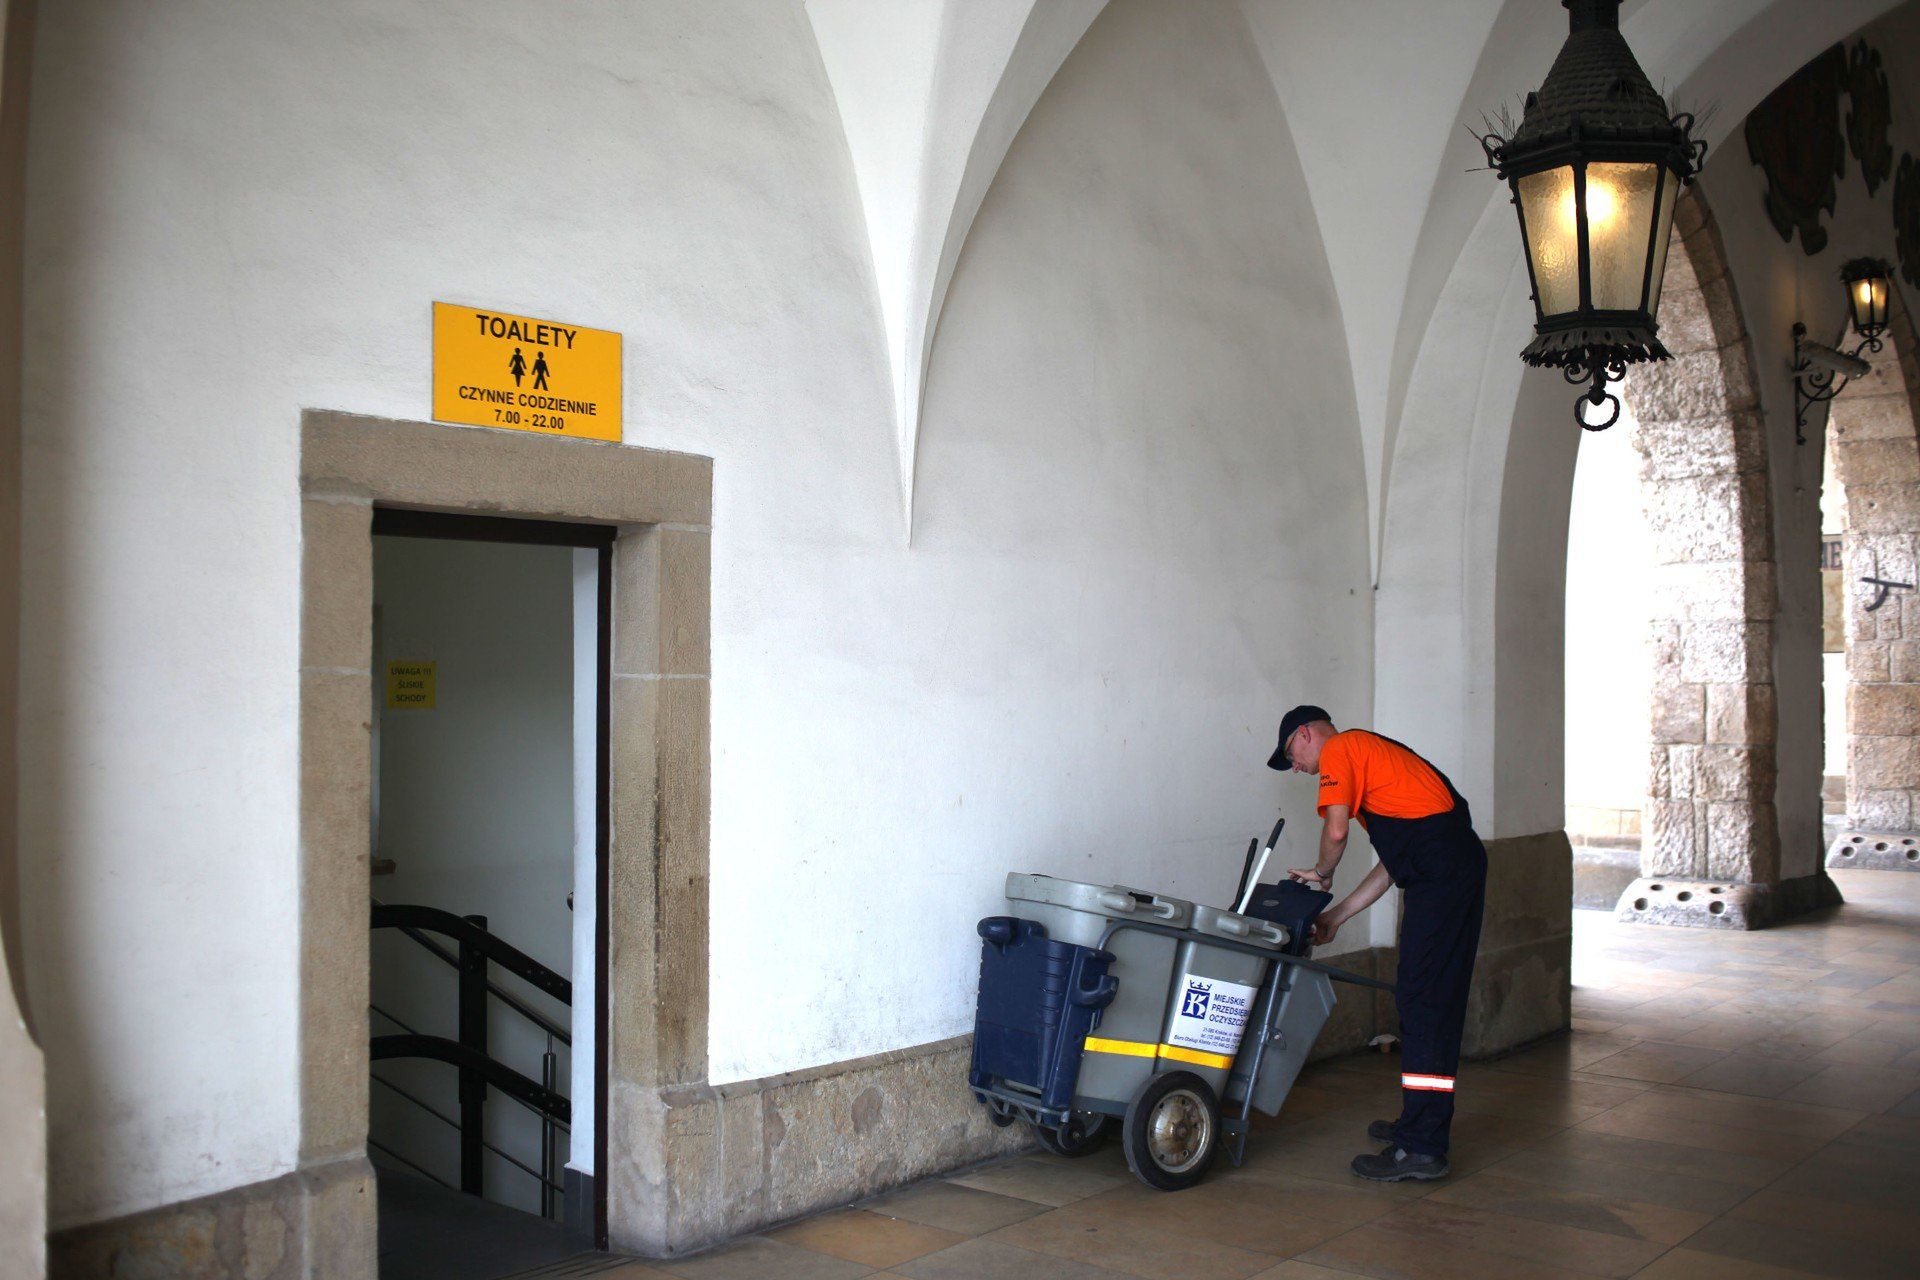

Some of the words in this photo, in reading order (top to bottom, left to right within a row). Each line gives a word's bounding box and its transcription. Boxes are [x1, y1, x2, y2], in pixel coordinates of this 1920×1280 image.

[476, 314, 577, 349] TOALETY
[459, 386, 515, 405] CZYNNE
[518, 394, 597, 415] CODZIENNIE
[495, 410, 520, 424] 7.00
[532, 414, 564, 430] 22.00
[395, 694, 426, 702] SCHODY
[1214, 993, 1246, 1006] MIEJSKIE
